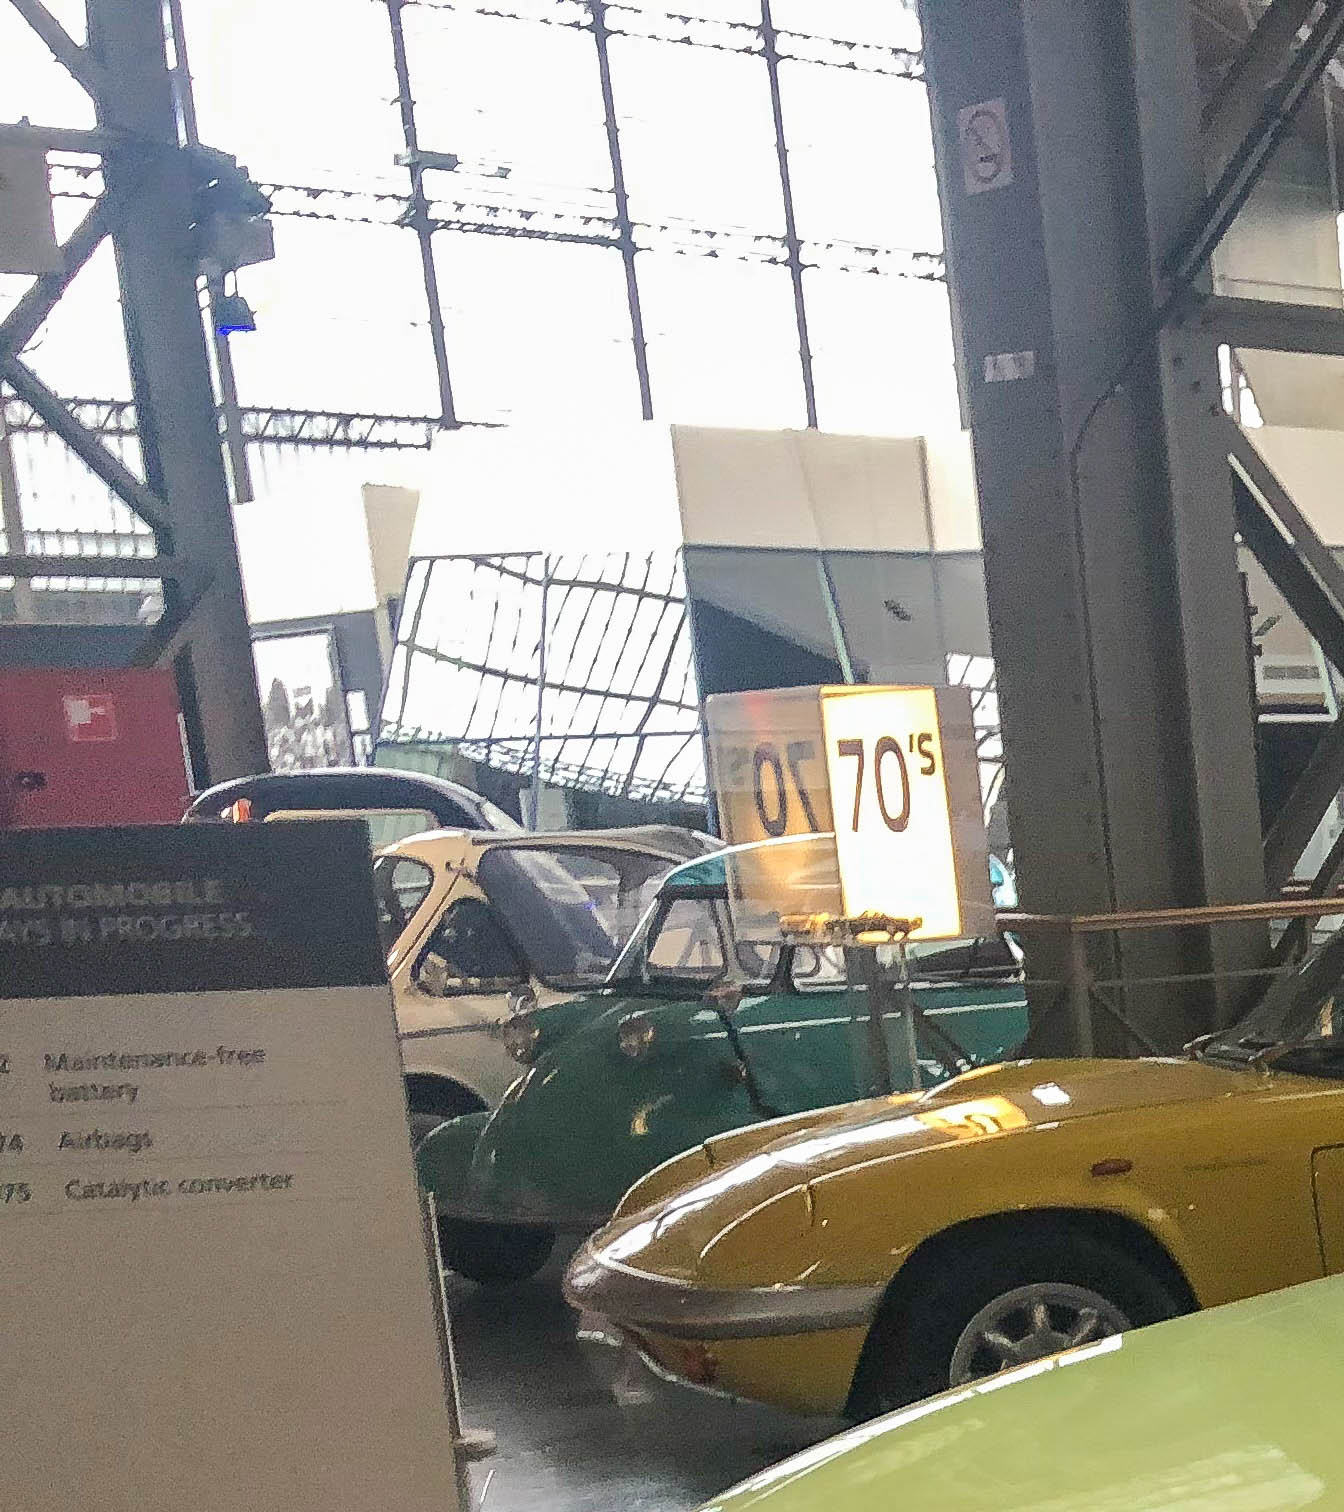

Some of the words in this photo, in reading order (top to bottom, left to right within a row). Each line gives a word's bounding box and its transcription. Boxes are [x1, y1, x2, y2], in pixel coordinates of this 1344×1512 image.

[99, 912, 252, 940] PROGRESS
[44, 1045, 267, 1072] Maintenance-free
[48, 1081, 139, 1105] battery
[58, 1129, 153, 1153] Airbags
[64, 1177, 170, 1203] Catalytic
[178, 1172, 293, 1195] converter
